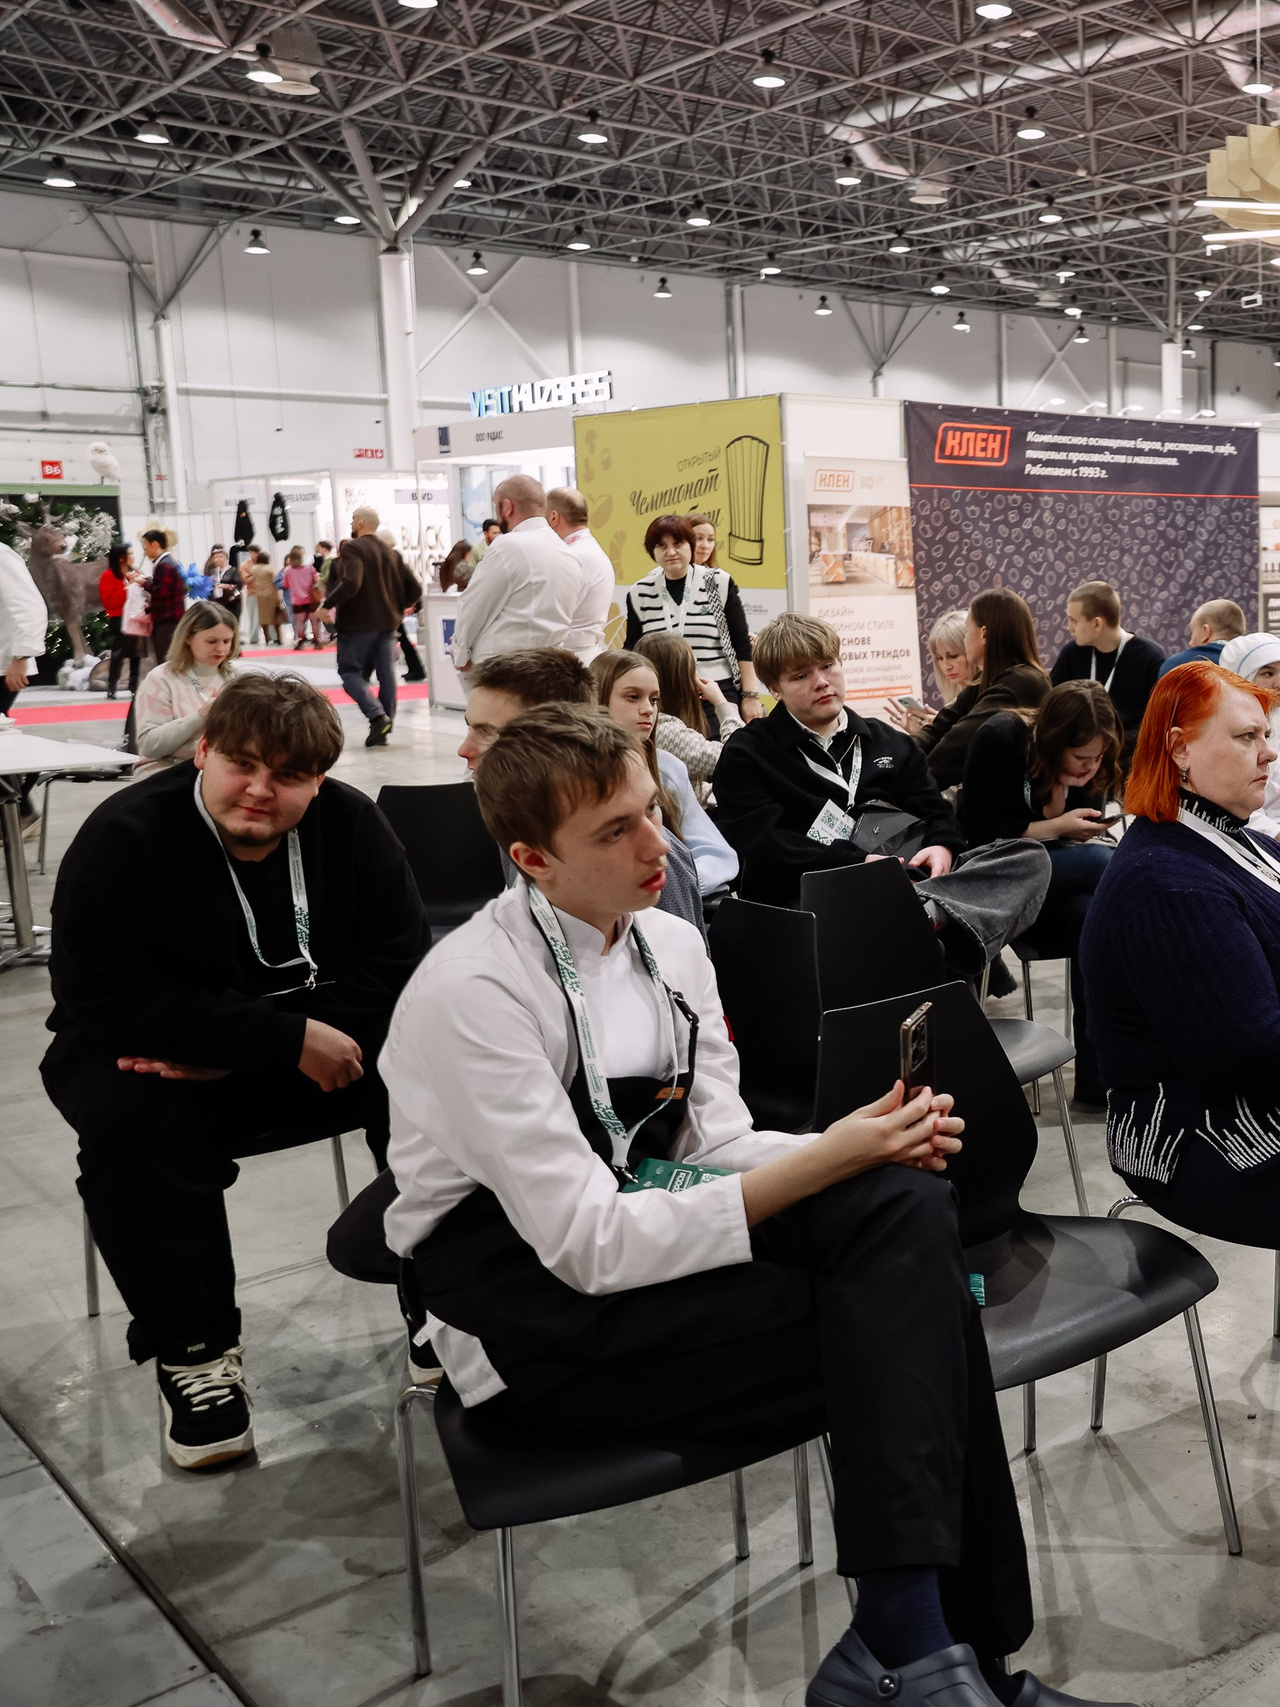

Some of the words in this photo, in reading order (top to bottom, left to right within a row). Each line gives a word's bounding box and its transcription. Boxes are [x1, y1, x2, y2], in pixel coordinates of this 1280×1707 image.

[944, 430, 1002, 459] КЛЕН
[1026, 431, 1088, 445] Комплексное
[1088, 437, 1136, 449] оснащение
[1136, 438, 1163, 452] баров,
[1163, 442, 1215, 454] ресторанов,
[1215, 443, 1238, 456] кафе,
[678, 446, 721, 471] ОТКРЫТЫЙ
[1025, 449, 1067, 461] пищевых
[1068, 451, 1126, 464] производств
[1133, 456, 1180, 466] магазинов.
[1024, 464, 1071, 477] Работаем
[1072, 469, 1078, 477] с
[1079, 466, 1100, 478] 1993
[1100, 469, 1108, 478] г.
[819, 472, 850, 488] КЛЕН
[411, 492, 433, 501] BVD
[630, 467, 720, 516] Чемпионат
[401, 525, 444, 550] BLCK
[817, 606, 854, 618] ДИЗАЙН
[833, 621, 866, 631] ДИНОМ
[867, 620, 895, 631] СТИЛЕ
[841, 637, 872, 646] СНОВЕ
[842, 651, 868, 661] ОВЫХ
[871, 649, 911, 660] ТРЕНДОВ
